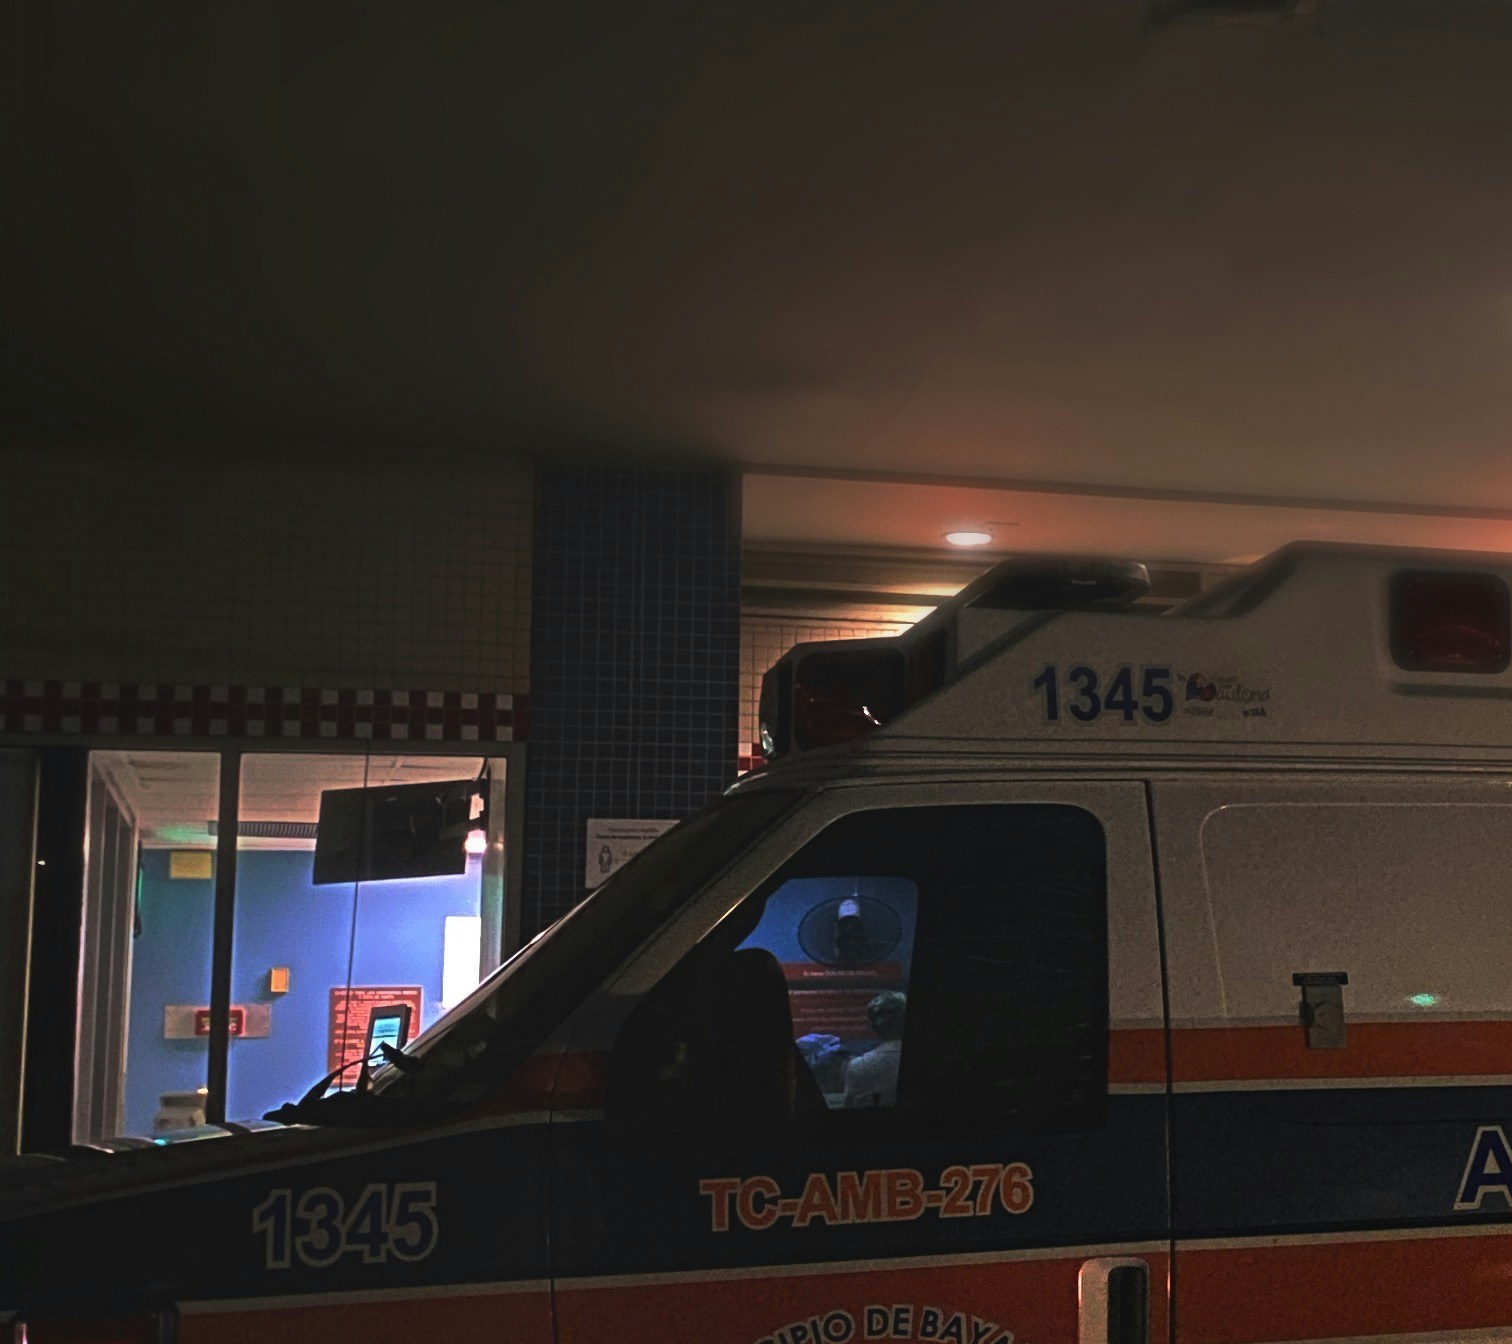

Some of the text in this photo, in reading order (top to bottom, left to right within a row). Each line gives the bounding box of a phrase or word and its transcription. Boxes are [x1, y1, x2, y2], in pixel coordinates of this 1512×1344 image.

[1033, 665, 1175, 722] 1345
[252, 1181, 440, 1270] 1345
[699, 1162, 1034, 1232] TC-AMB-276
[864, 1306, 913, 1339] DE
